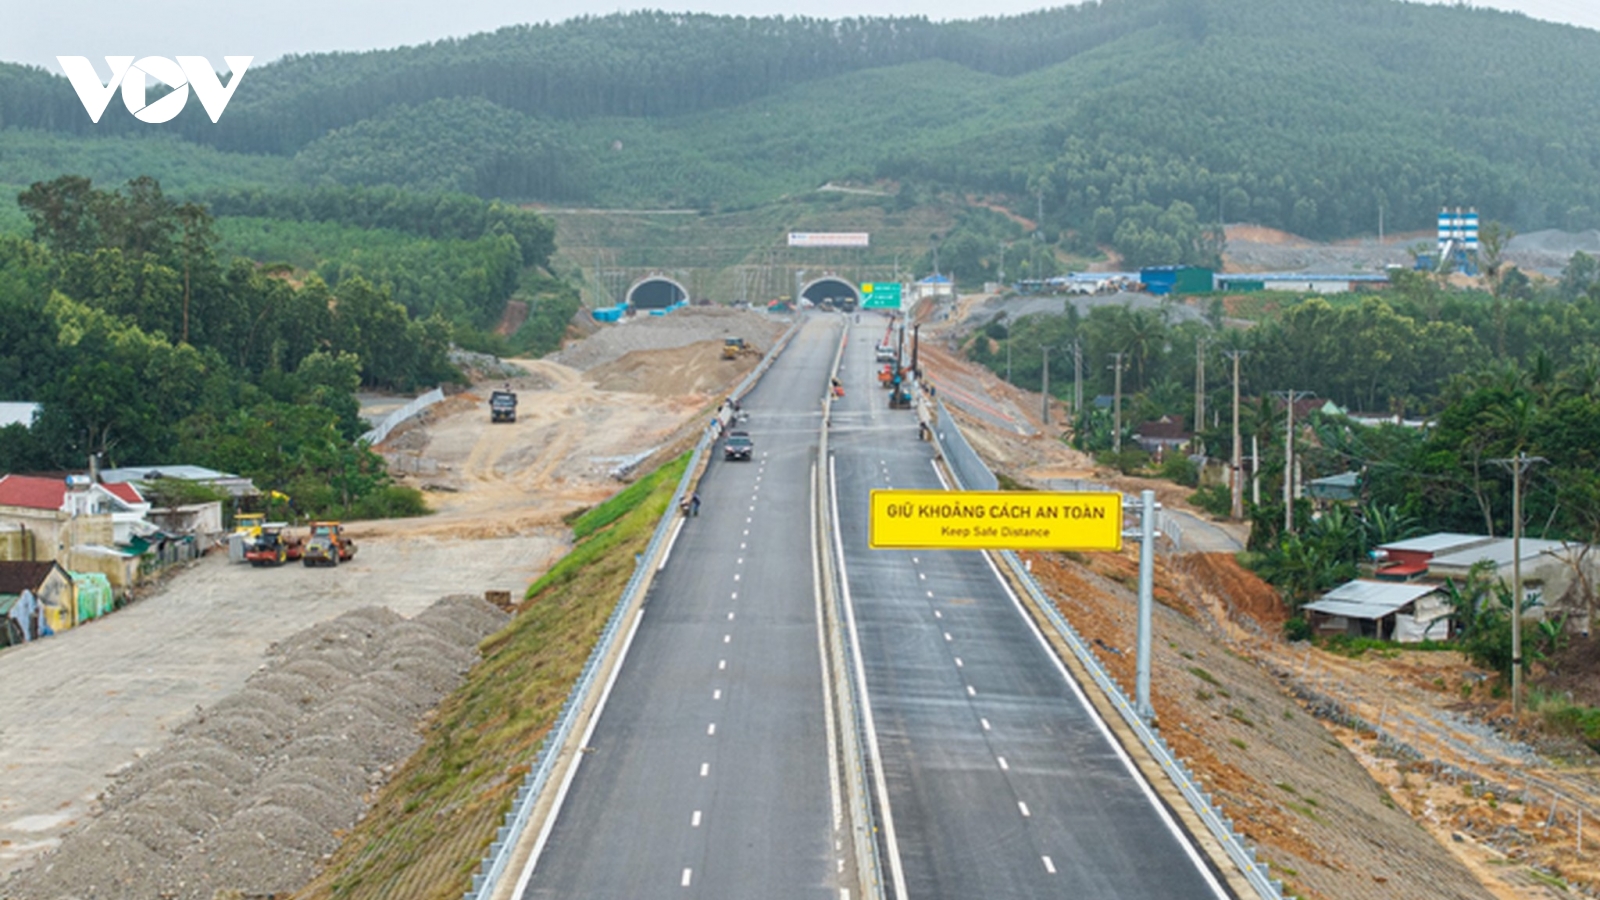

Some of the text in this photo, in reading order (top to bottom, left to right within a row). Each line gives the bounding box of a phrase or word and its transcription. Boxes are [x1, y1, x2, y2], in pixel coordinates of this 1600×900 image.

[887, 501, 1105, 519] GIỮ KHOẢNG CÁCH AN TOÀN
[941, 526, 1050, 538] Keep Safe Distance
